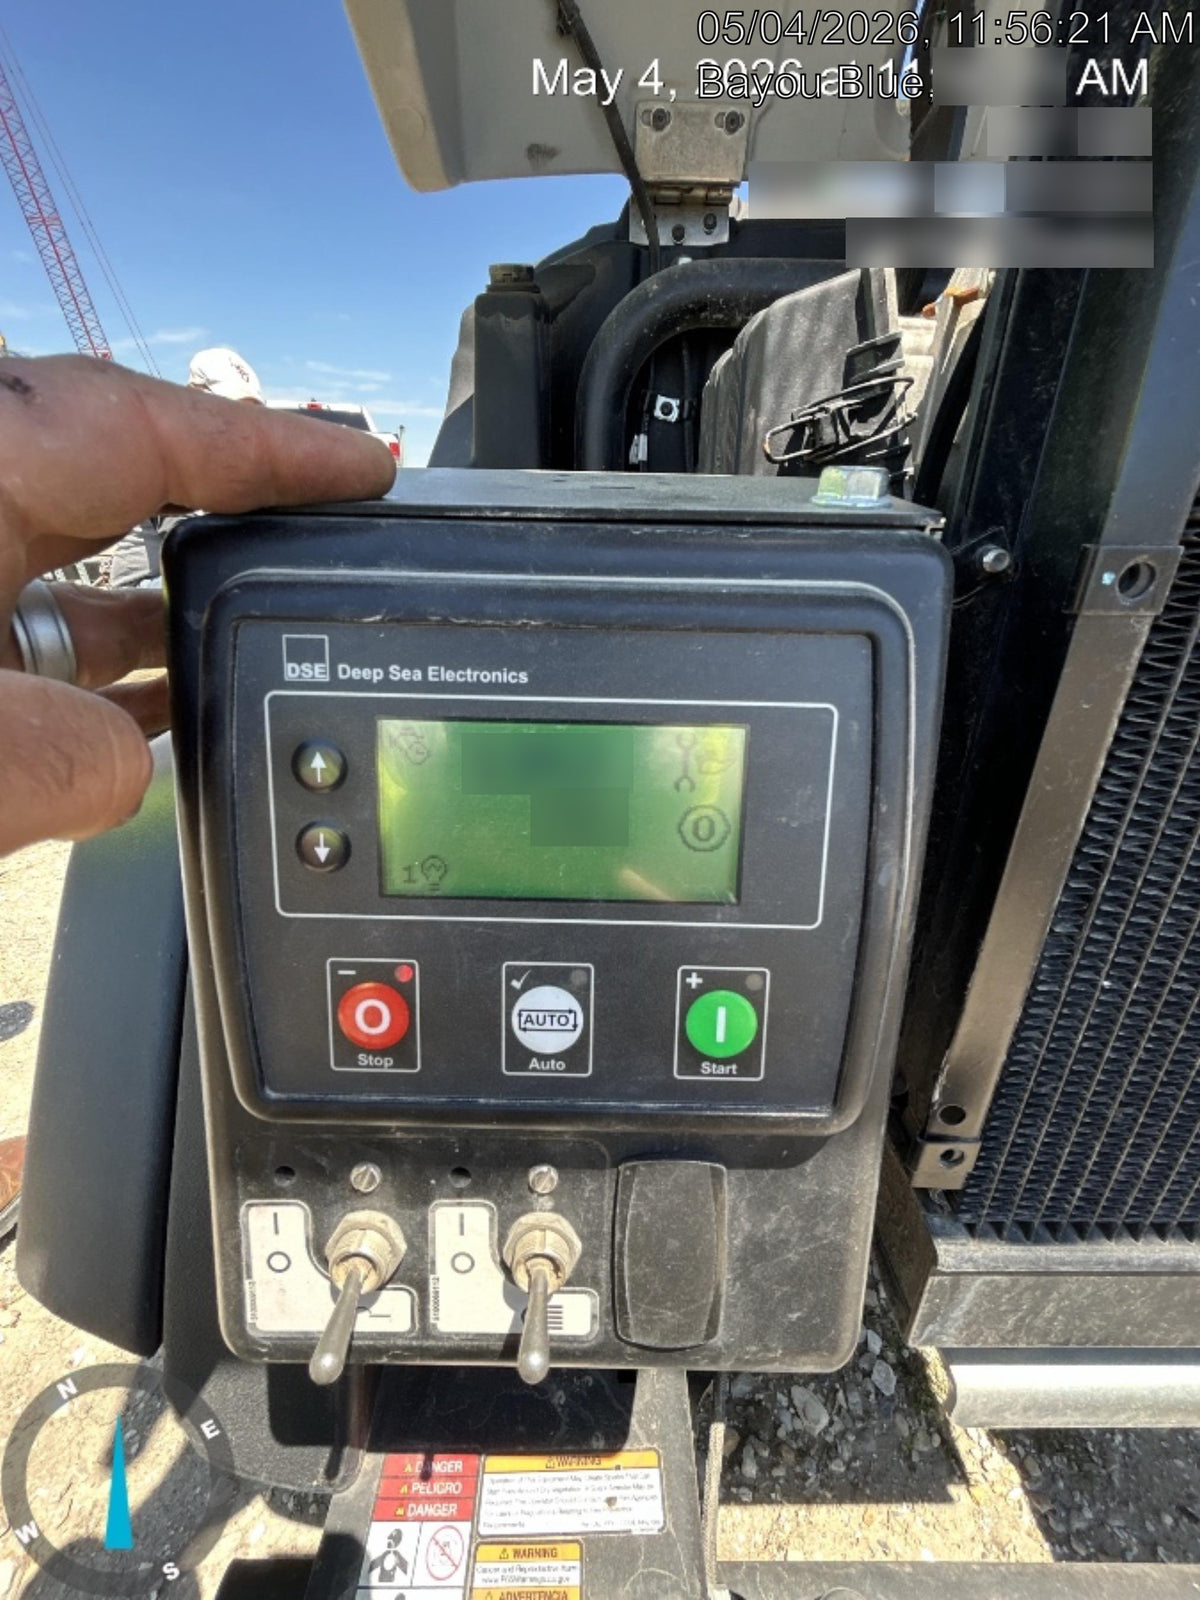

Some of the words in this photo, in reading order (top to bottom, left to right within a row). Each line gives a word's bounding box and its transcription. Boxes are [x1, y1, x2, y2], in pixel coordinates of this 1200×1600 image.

[286, 662, 328, 679] DSE
[337, 664, 384, 684] Deep
[388, 665, 422, 682] Sea
[427, 666, 529, 684] Electronics
[522, 1013, 570, 1027] AUTO
[357, 1053, 394, 1069] Stop
[528, 1057, 567, 1072] Auto
[700, 1060, 738, 1075] Start
[415, 1460, 464, 1473] DANGER
[411, 1481, 463, 1495] PELIGRO
[407, 1502, 458, 1517] DANGER
[512, 1547, 558, 1559] WARNING
